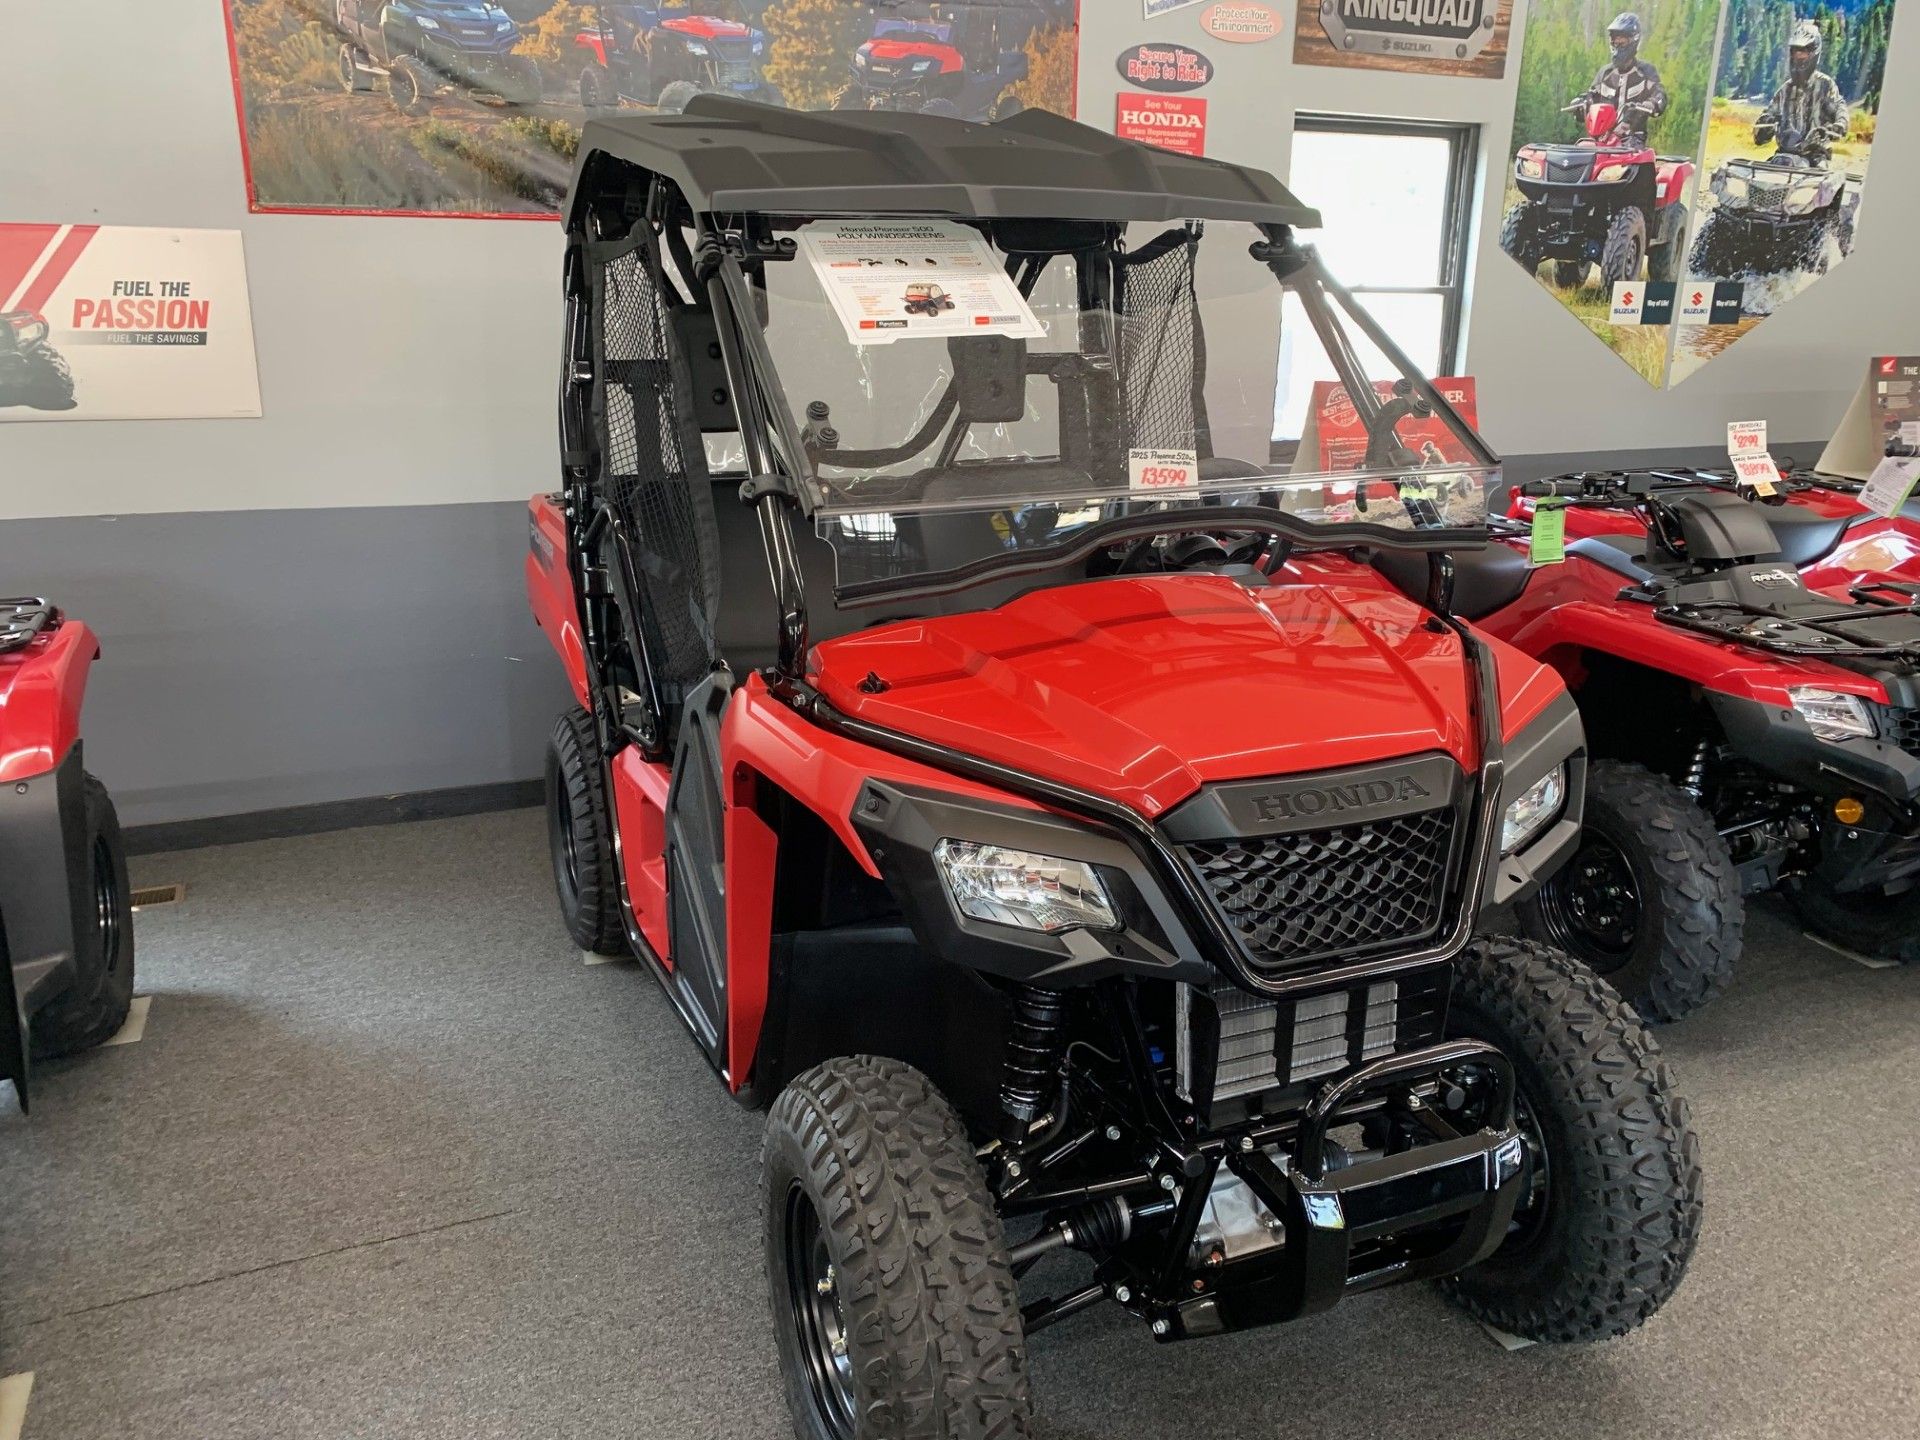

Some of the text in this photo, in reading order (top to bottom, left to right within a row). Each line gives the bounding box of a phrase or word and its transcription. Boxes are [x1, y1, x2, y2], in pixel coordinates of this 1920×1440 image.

[1215, 6, 1269, 20] Protect Your
[1344, 0, 1475, 28] KINGQUAD
[1211, 18, 1273, 33] Environment
[1393, 41, 1432, 53] SUZUKI
[1139, 46, 1197, 65] Secure Your
[1127, 59, 1207, 83] Right to Ride!
[1144, 99, 1182, 111] See Your
[1121, 110, 1203, 129] HONDA
[1126, 127, 1197, 139] Sales Representative
[112, 280, 190, 297] FUEL THE
[72, 298, 210, 329] PASSION
[107, 333, 200, 344] FUEL THE SAVINGS
[1903, 366, 1919, 375] THE
[1130, 451, 1149, 459] 2025
[1252, 775, 1430, 821] HONDA
